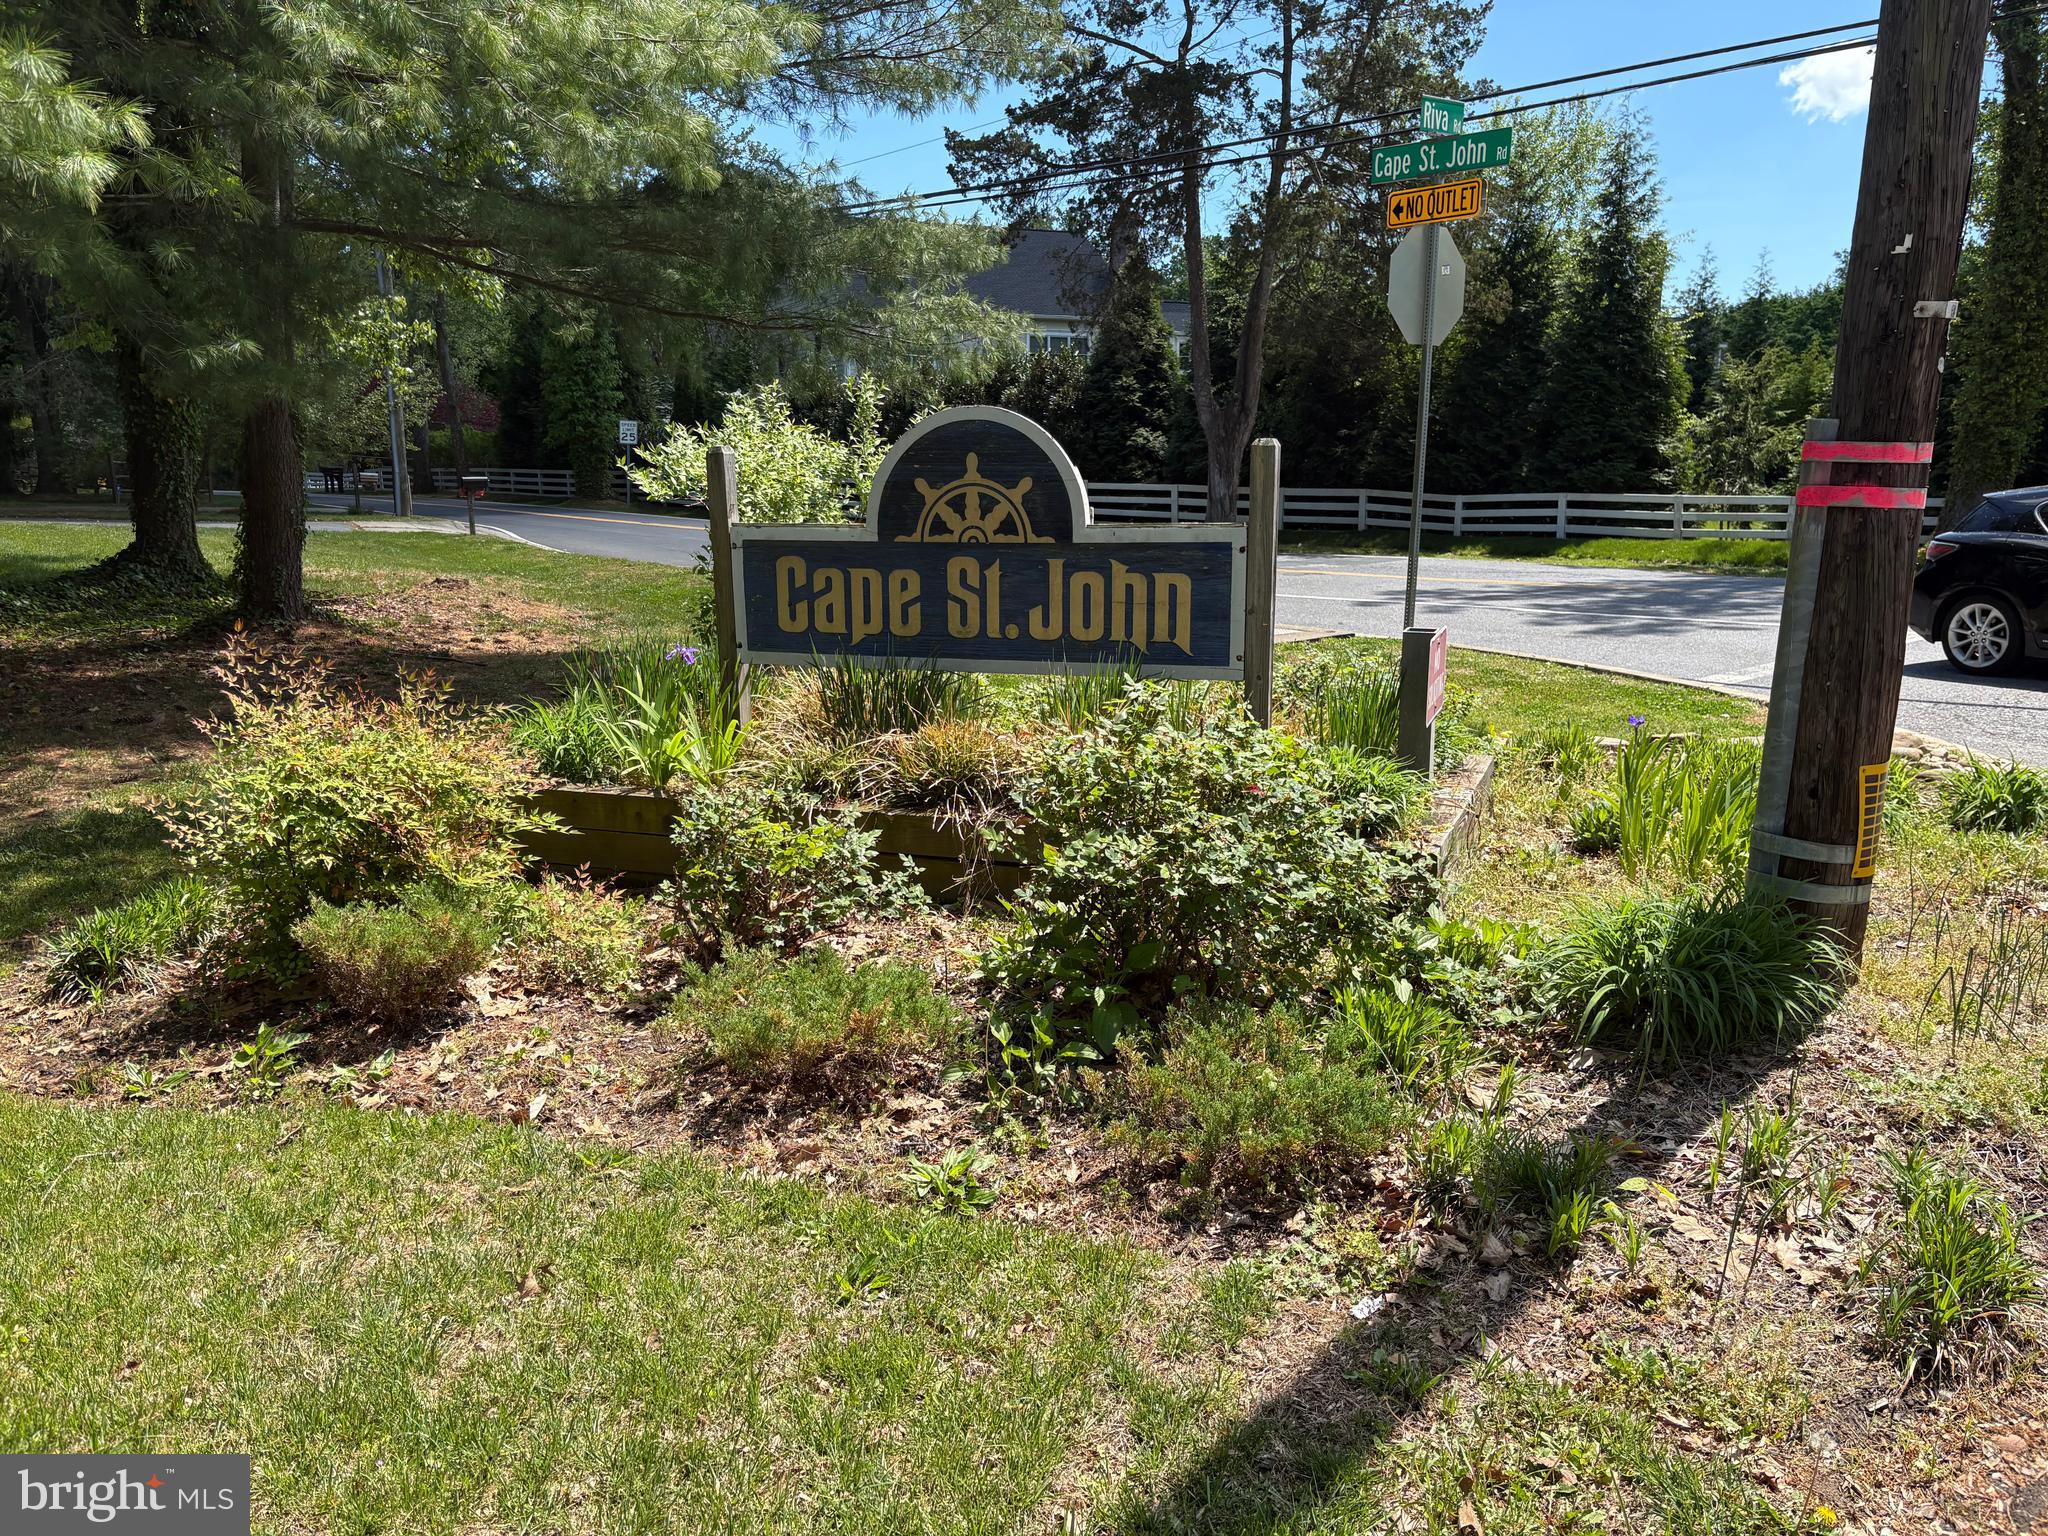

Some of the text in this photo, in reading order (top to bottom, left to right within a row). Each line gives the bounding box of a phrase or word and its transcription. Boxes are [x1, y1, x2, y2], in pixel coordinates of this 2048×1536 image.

[1423, 101, 1463, 133] Riva Rd
[1375, 139, 1507, 180] Cape St. John Rd
[1406, 186, 1477, 219] NO OUTLET
[621, 432, 636, 441] 25
[775, 555, 922, 646] Cape
